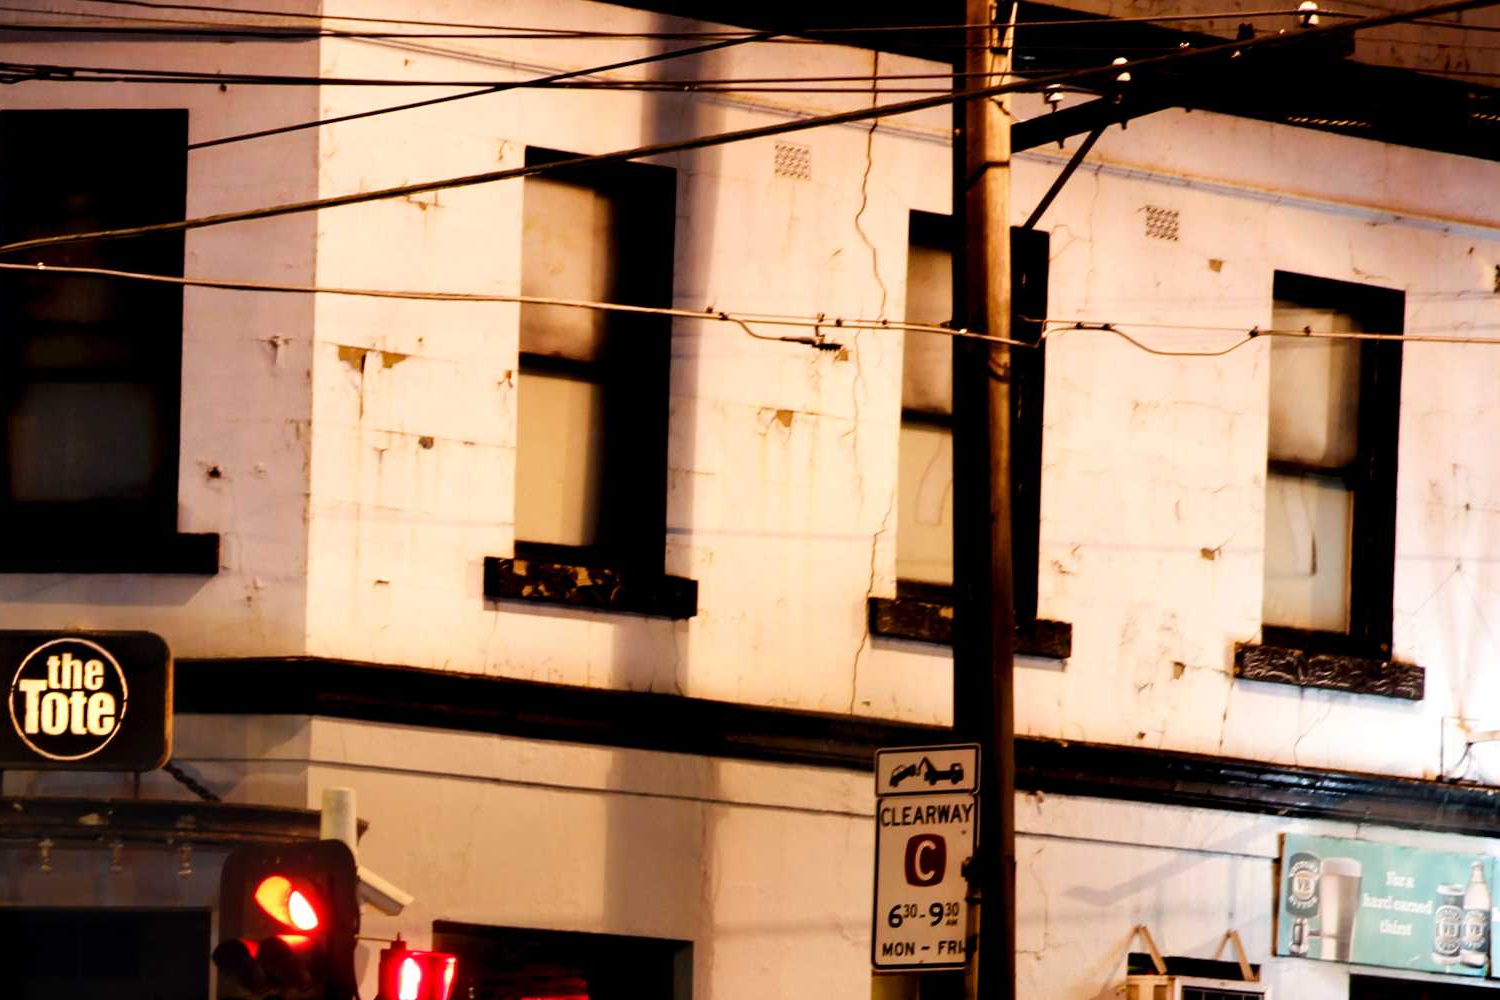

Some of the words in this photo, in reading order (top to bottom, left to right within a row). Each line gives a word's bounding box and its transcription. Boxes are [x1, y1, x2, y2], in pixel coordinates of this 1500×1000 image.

[47, 652, 104, 691] the
[19, 679, 116, 736] Tote
[880, 803, 974, 827] CLEARWAY
[882, 942, 915, 956] MON
[938, 940, 963, 955] FRI
